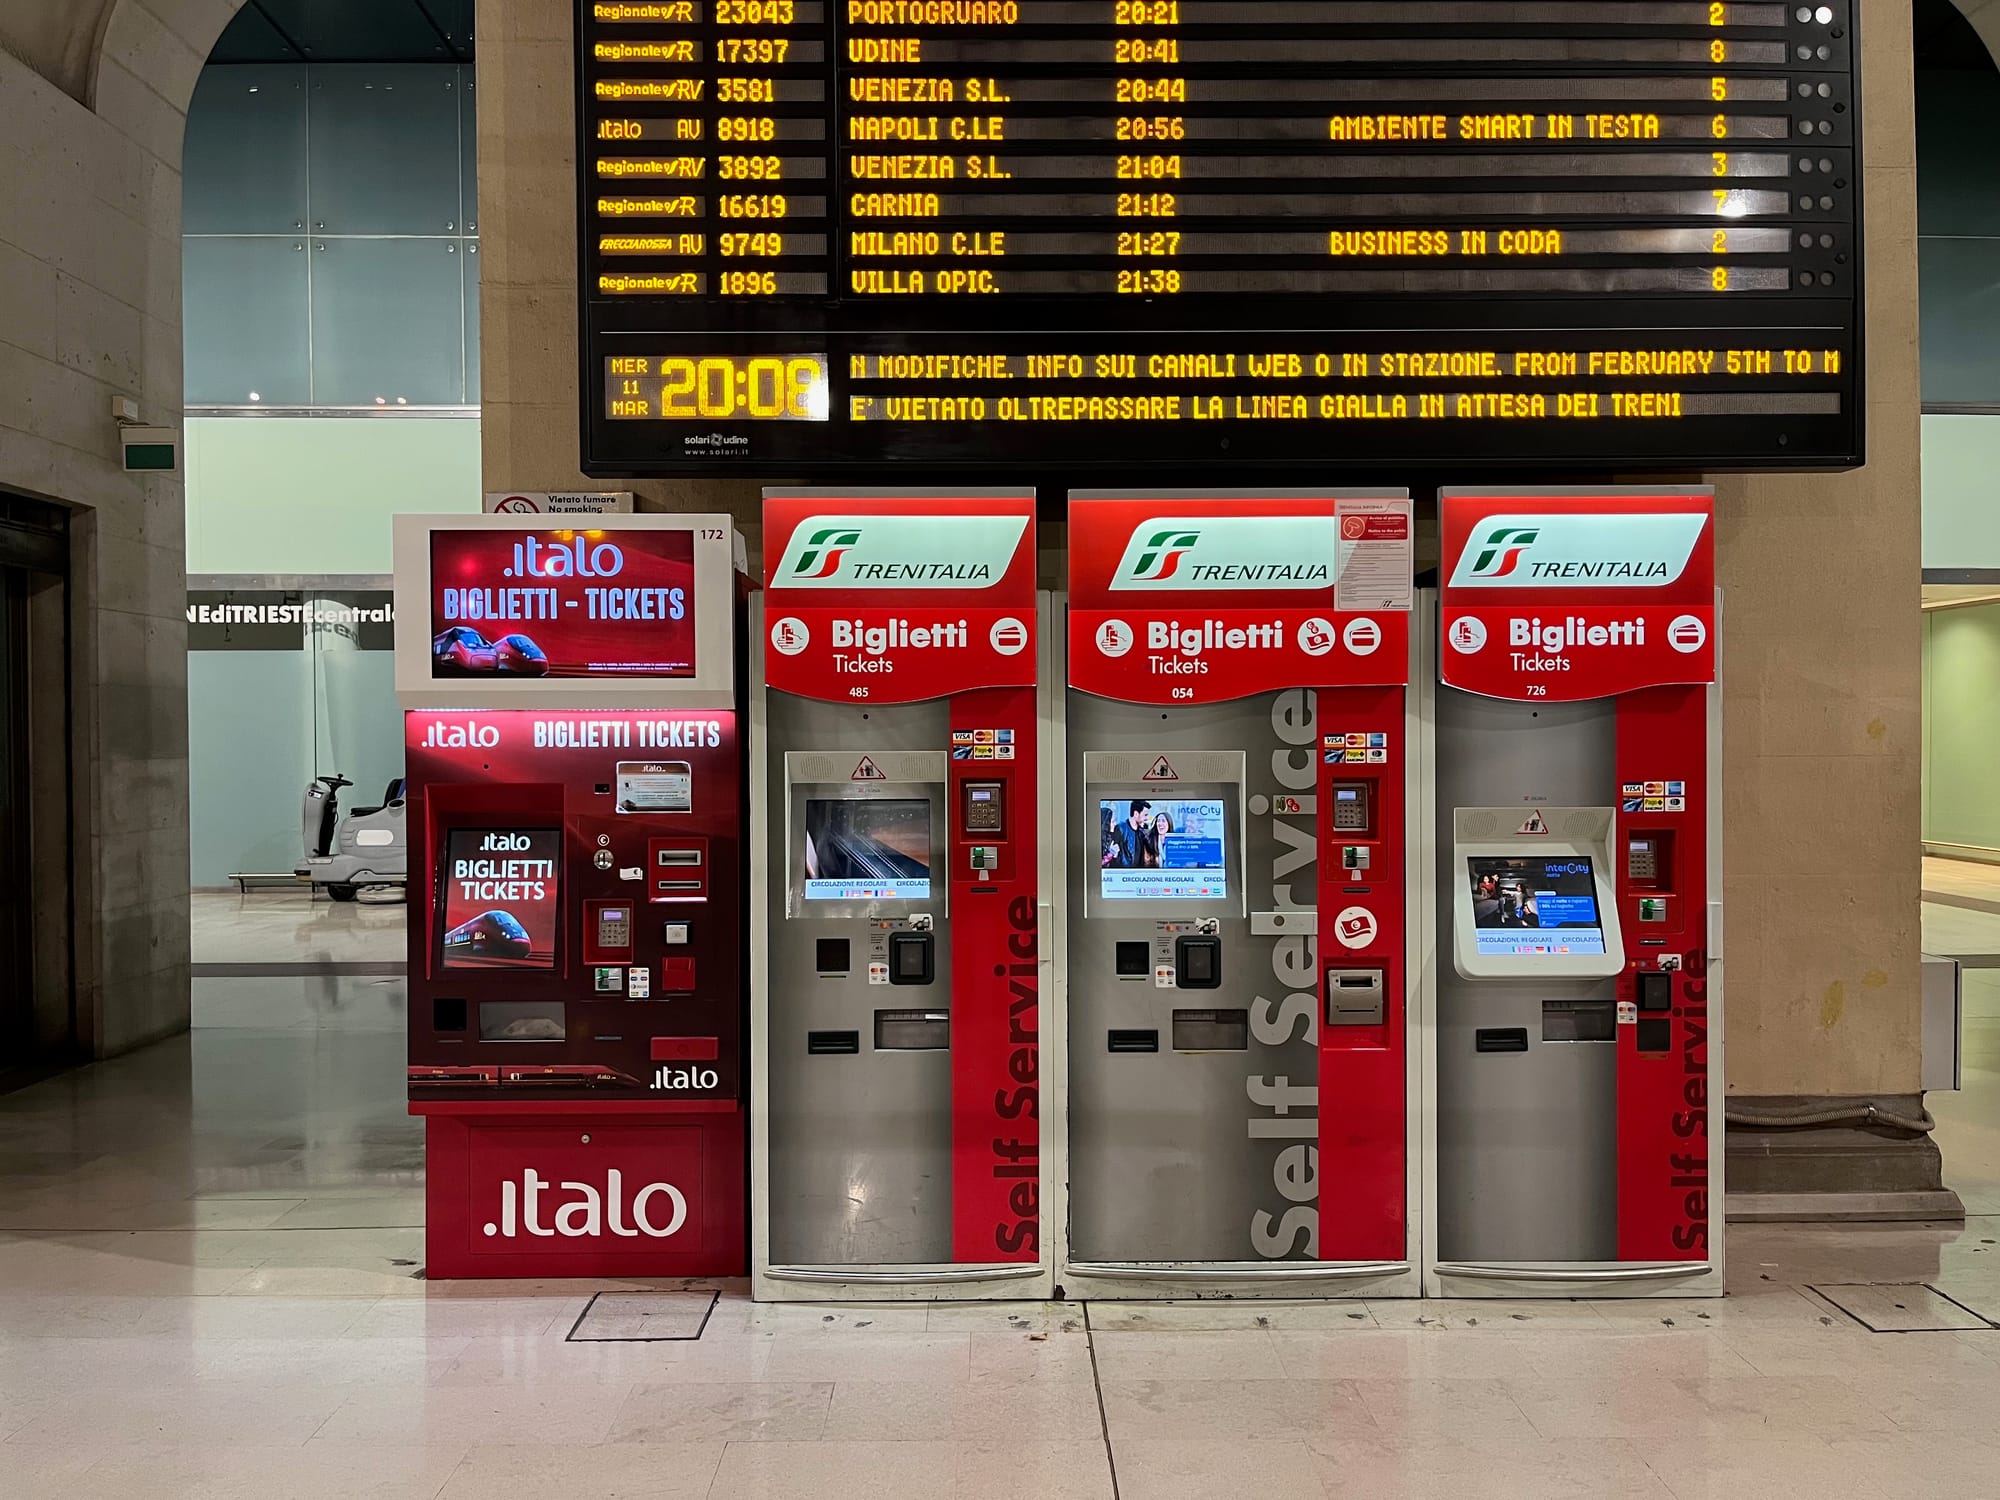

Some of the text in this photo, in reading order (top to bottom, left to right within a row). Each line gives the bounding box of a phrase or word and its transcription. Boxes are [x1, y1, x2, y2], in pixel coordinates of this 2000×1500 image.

[594, 4, 661, 20] Regionale
[717, 0, 793, 24] 23043
[849, 0, 1017, 24] PORTOGRUARO
[1116, 0, 1178, 24] 20:21
[1709, 2, 1726, 25] 2
[595, 43, 662, 59] Regionale
[717, 39, 788, 63] 17397
[849, 39, 920, 62] UDINE
[1116, 39, 1178, 62] 20:41
[1710, 40, 1726, 63] 8
[595, 78, 1728, 102] Regionale RV 3581 VENEZIA S.L. 20:44 5
[677, 119, 700, 139] AV
[718, 118, 774, 140] 8918
[850, 117, 938, 140] NAPOLI
[950, 117, 1003, 140] C.LE
[1117, 117, 1184, 140] 20:56
[1330, 116, 1446, 140] AMBIENTE
[1460, 115, 1534, 139] SMART
[1548, 115, 1574, 138] IN
[1586, 114, 1659, 138] TESTA
[1712, 115, 1727, 138] 6
[597, 153, 1728, 179] Regionale RV 3892 VENEZIA S.L. 21:04 3
[598, 198, 664, 214] Regionale
[720, 195, 786, 217] 16619
[852, 194, 939, 216] CARNIA
[1117, 194, 1175, 216] 21:12
[1713, 190, 1728, 214] 7
[599, 230, 1727, 256] FRECCIAROSSA AV 9749 MILANO C.LE 21:27 BUSINESS IN CODA 2
[599, 276, 665, 291] Regionale
[721, 272, 776, 294] 1896
[852, 271, 923, 293] VILLA
[937, 270, 999, 293] OPIC.
[1118, 270, 1180, 293] 21:38
[1712, 267, 1728, 291] 8
[612, 358, 648, 374] MER
[851, 351, 1838, 378] N MODIFICHE. INFO SUI CANALI WEB O IN STAZIONE. FROM FEBRUARY 5TH TO M
[623, 380, 639, 395] 11
[612, 400, 649, 416] MAR
[852, 393, 1682, 420] E' VIETATO OLTREPASSARE LA LINEA GIALLA IN ATTESA DEI TRENI
[684, 435, 748, 445] solari udine
[548, 495, 616, 503] Vietato fumare
[548, 505, 603, 513] No smoking
[700, 529, 723, 541] 172
[853, 563, 990, 579] TRENITALIA
[1192, 564, 1328, 581] TRENITALIA
[1530, 562, 1668, 578] TRENITALIA
[443, 588, 558, 620] BIGLIETTI
[584, 587, 685, 620] TICKETS
[831, 618, 968, 655] Biglietti
[1147, 619, 1283, 655] Biglietti
[1509, 616, 1645, 654] Biglietti
[832, 654, 894, 674] Tickets
[1148, 655, 1209, 675] Tickets
[1510, 652, 1571, 672] Tickets
[850, 687, 869, 698] 485
[1172, 687, 1194, 699] 054
[1527, 685, 1546, 696] 726
[533, 721, 720, 748] BIGLIETTI TICKETS
[454, 859, 553, 880] BIGLIETTI
[460, 881, 546, 901] TICKETS
[1247, 688, 1319, 1259] Self Service
[993, 895, 1039, 1254] Self Service
[1670, 948, 1709, 1250] Self Service
